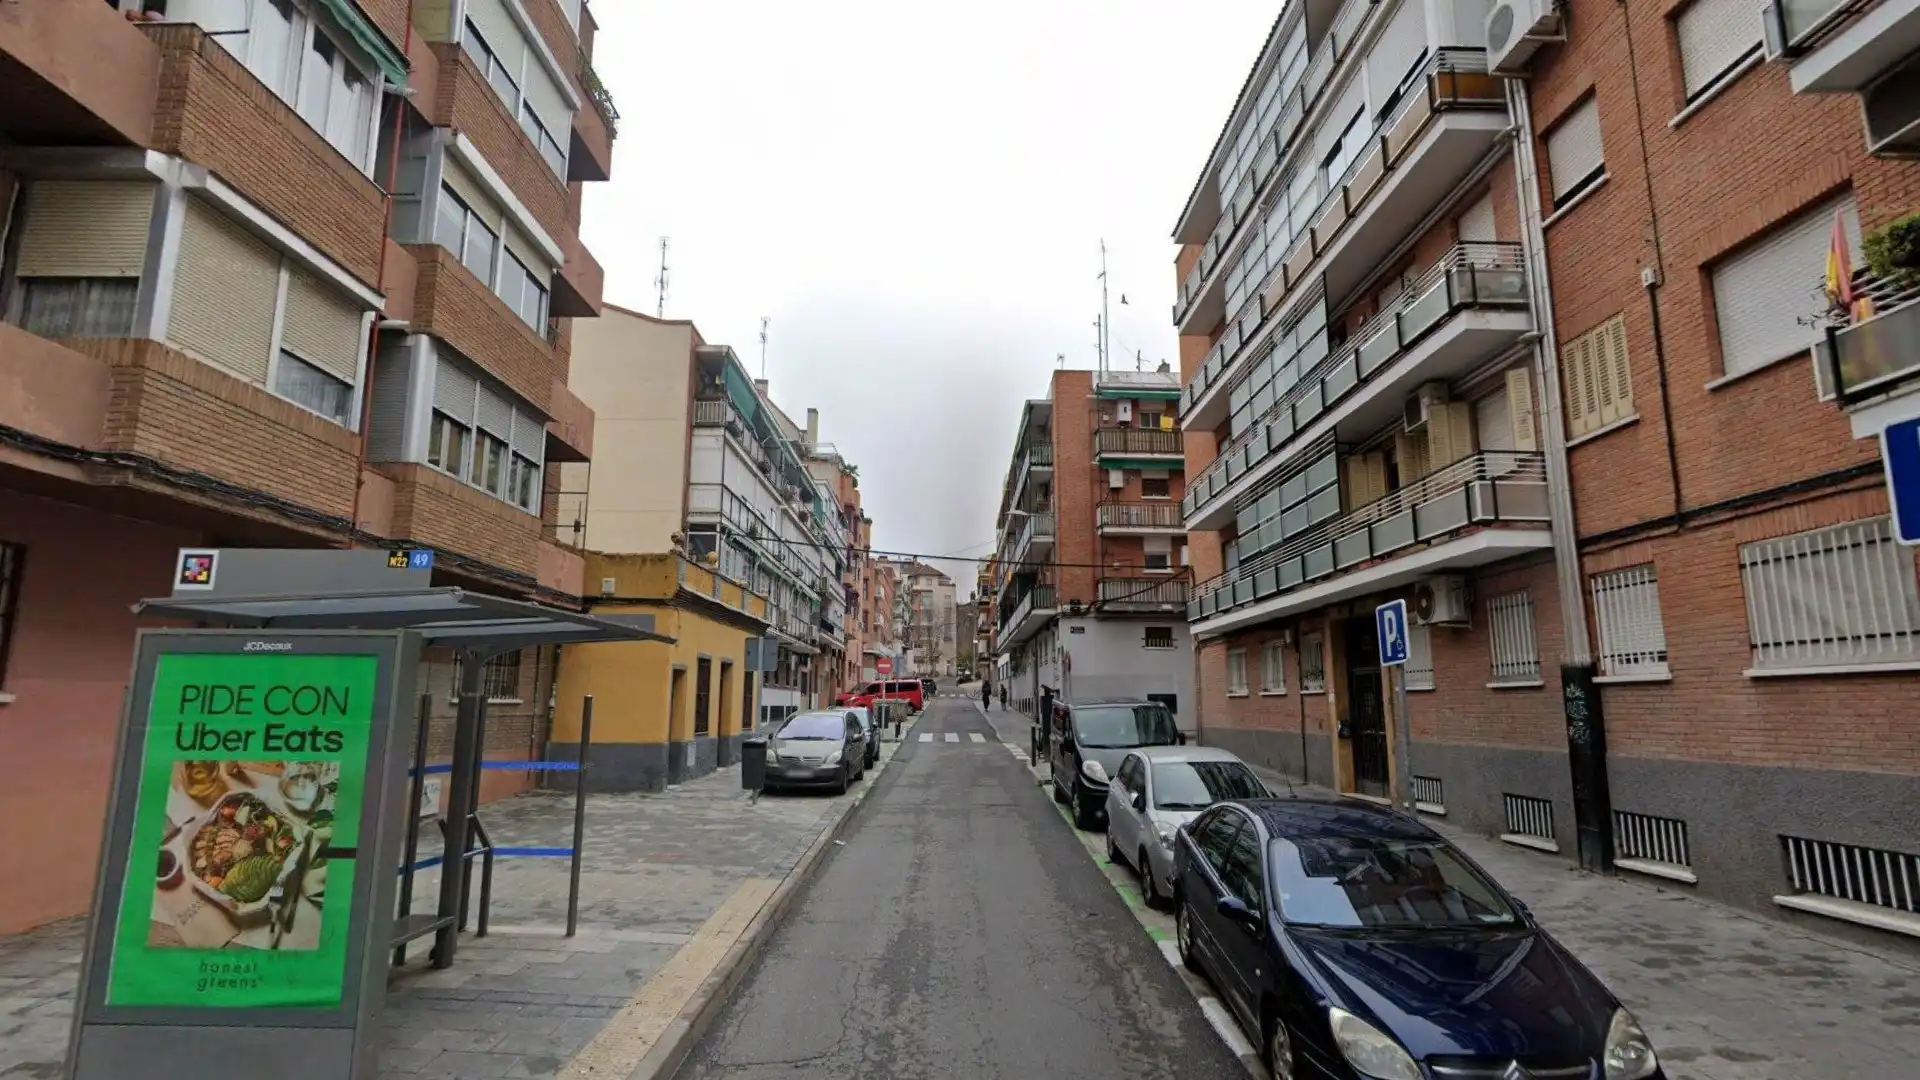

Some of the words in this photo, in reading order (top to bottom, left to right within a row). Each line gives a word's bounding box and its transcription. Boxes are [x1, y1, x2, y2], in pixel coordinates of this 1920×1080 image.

[414, 554, 429, 566] 49
[1383, 610, 1398, 657] P
[180, 684, 256, 715] PIDE
[263, 685, 350, 716] CON
[176, 721, 256, 752] Uber
[262, 723, 344, 752] Eats
